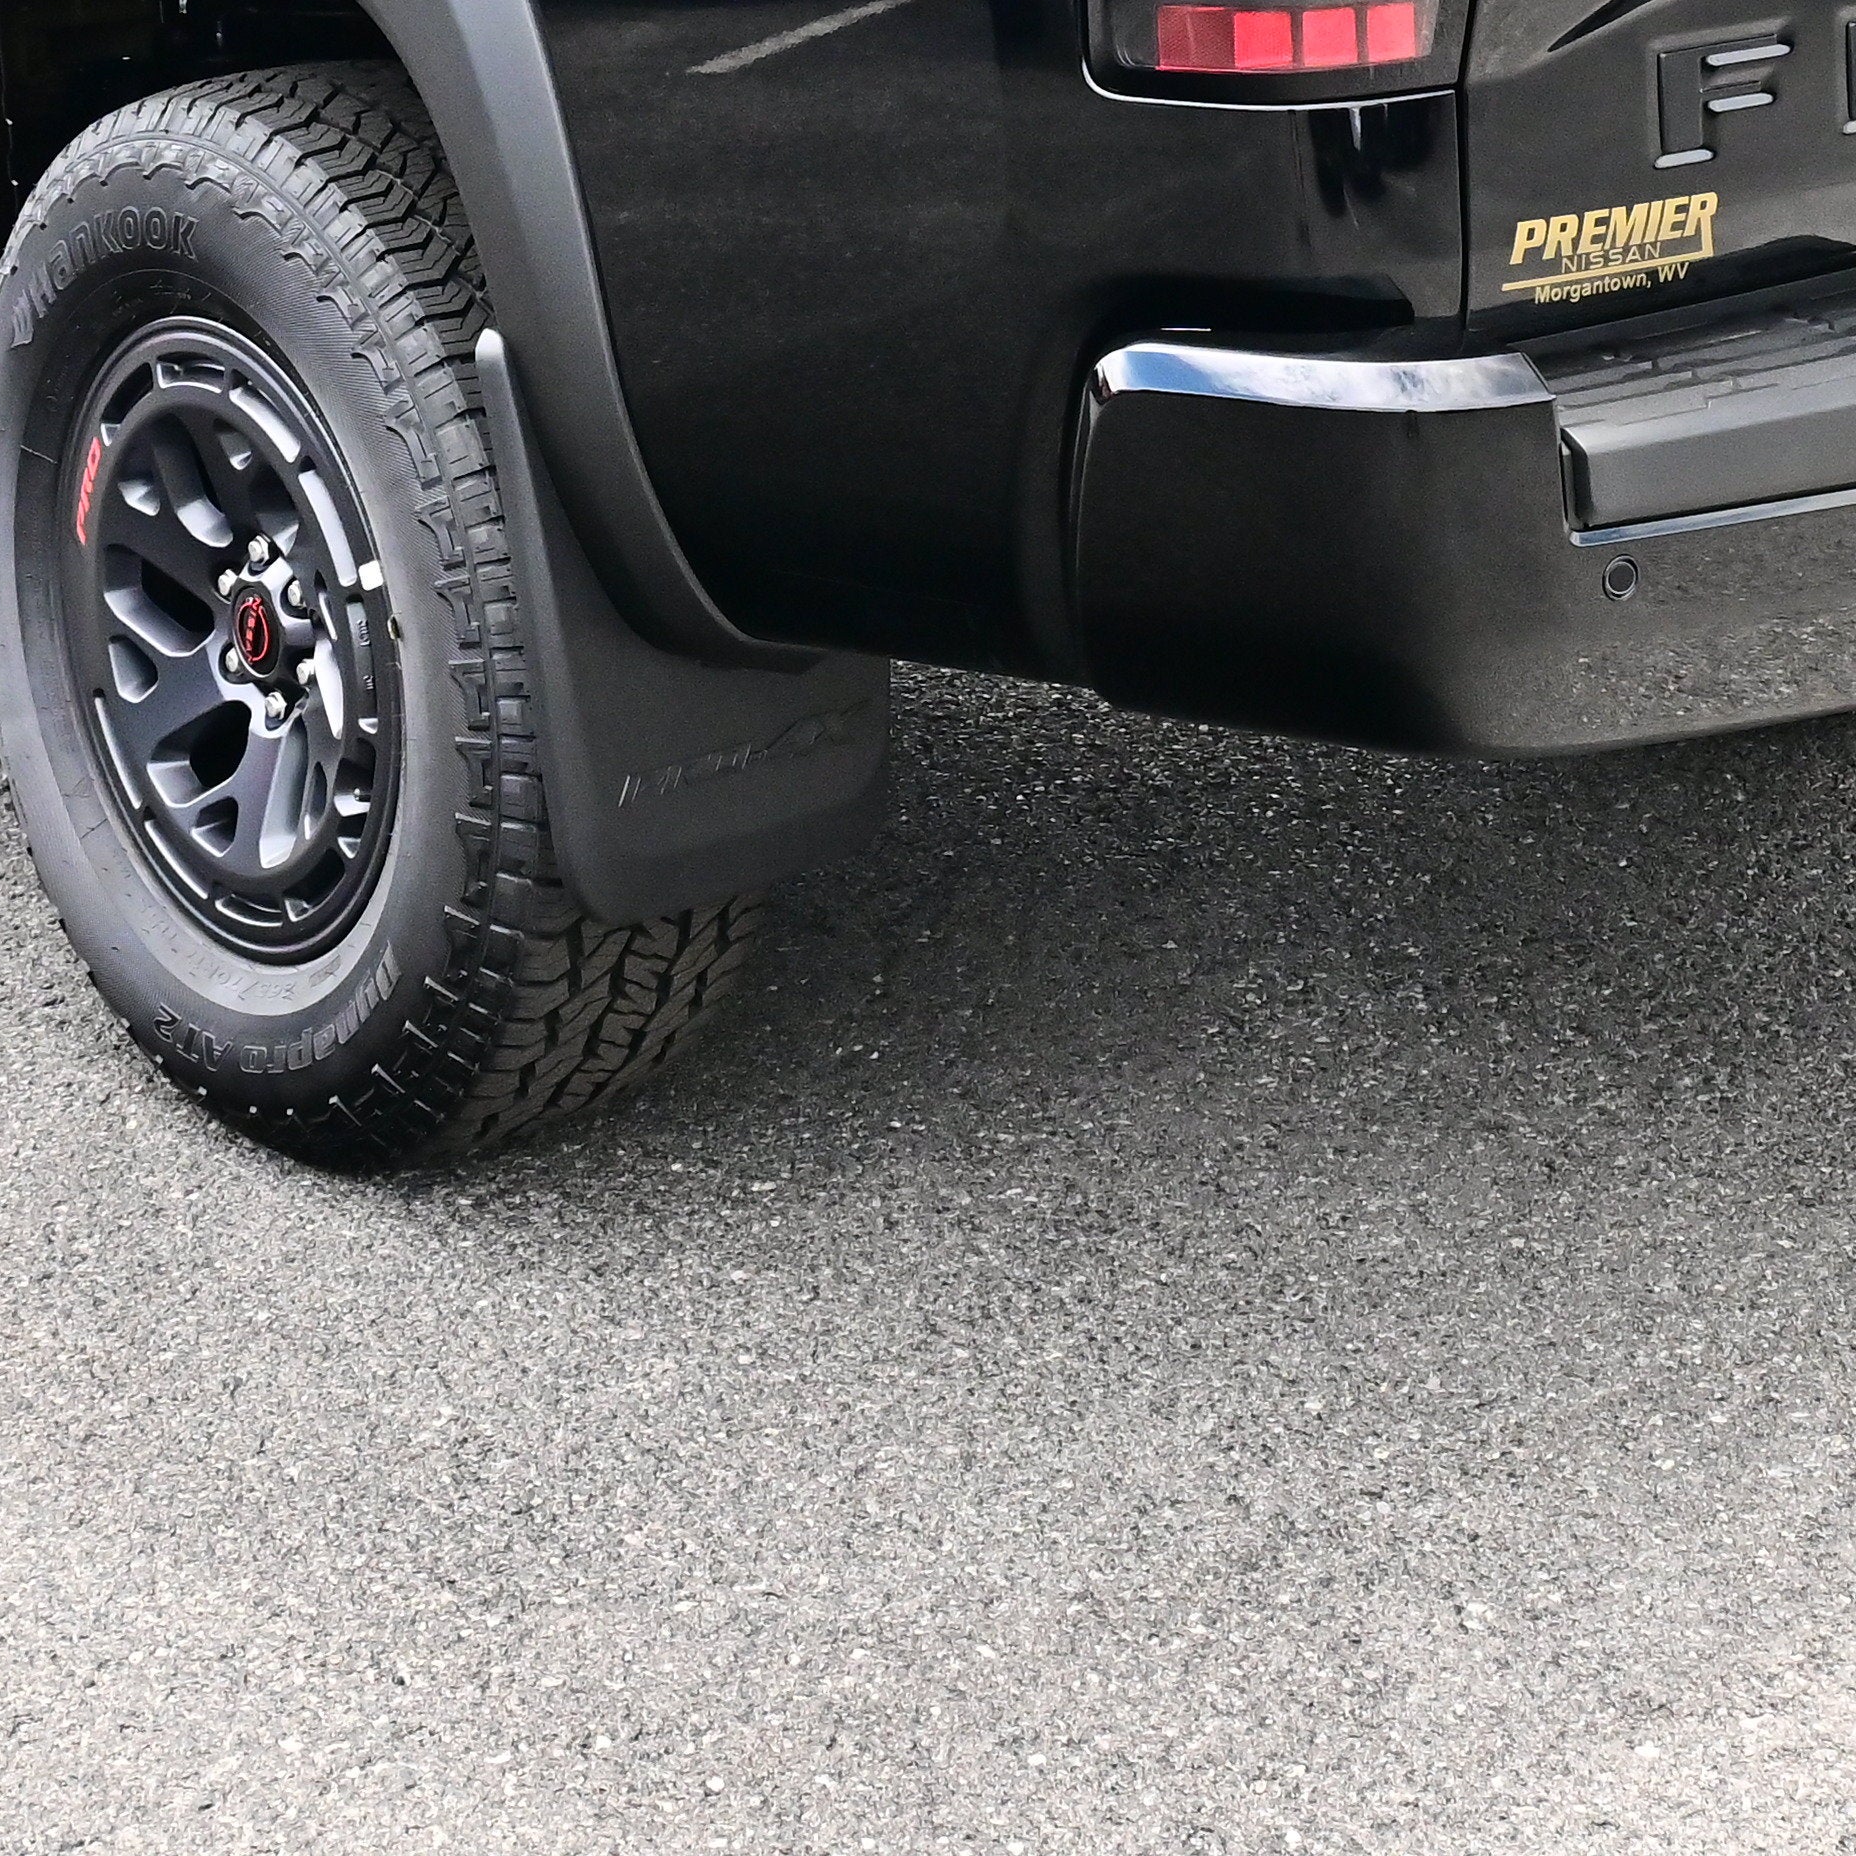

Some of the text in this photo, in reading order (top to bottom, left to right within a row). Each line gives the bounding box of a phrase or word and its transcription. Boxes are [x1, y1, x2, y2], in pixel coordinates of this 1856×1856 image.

[1509, 191, 1719, 265] PREMIER
[1561, 241, 1662, 274] NISSAN
[1535, 261, 1690, 304] Morgantown, WV
